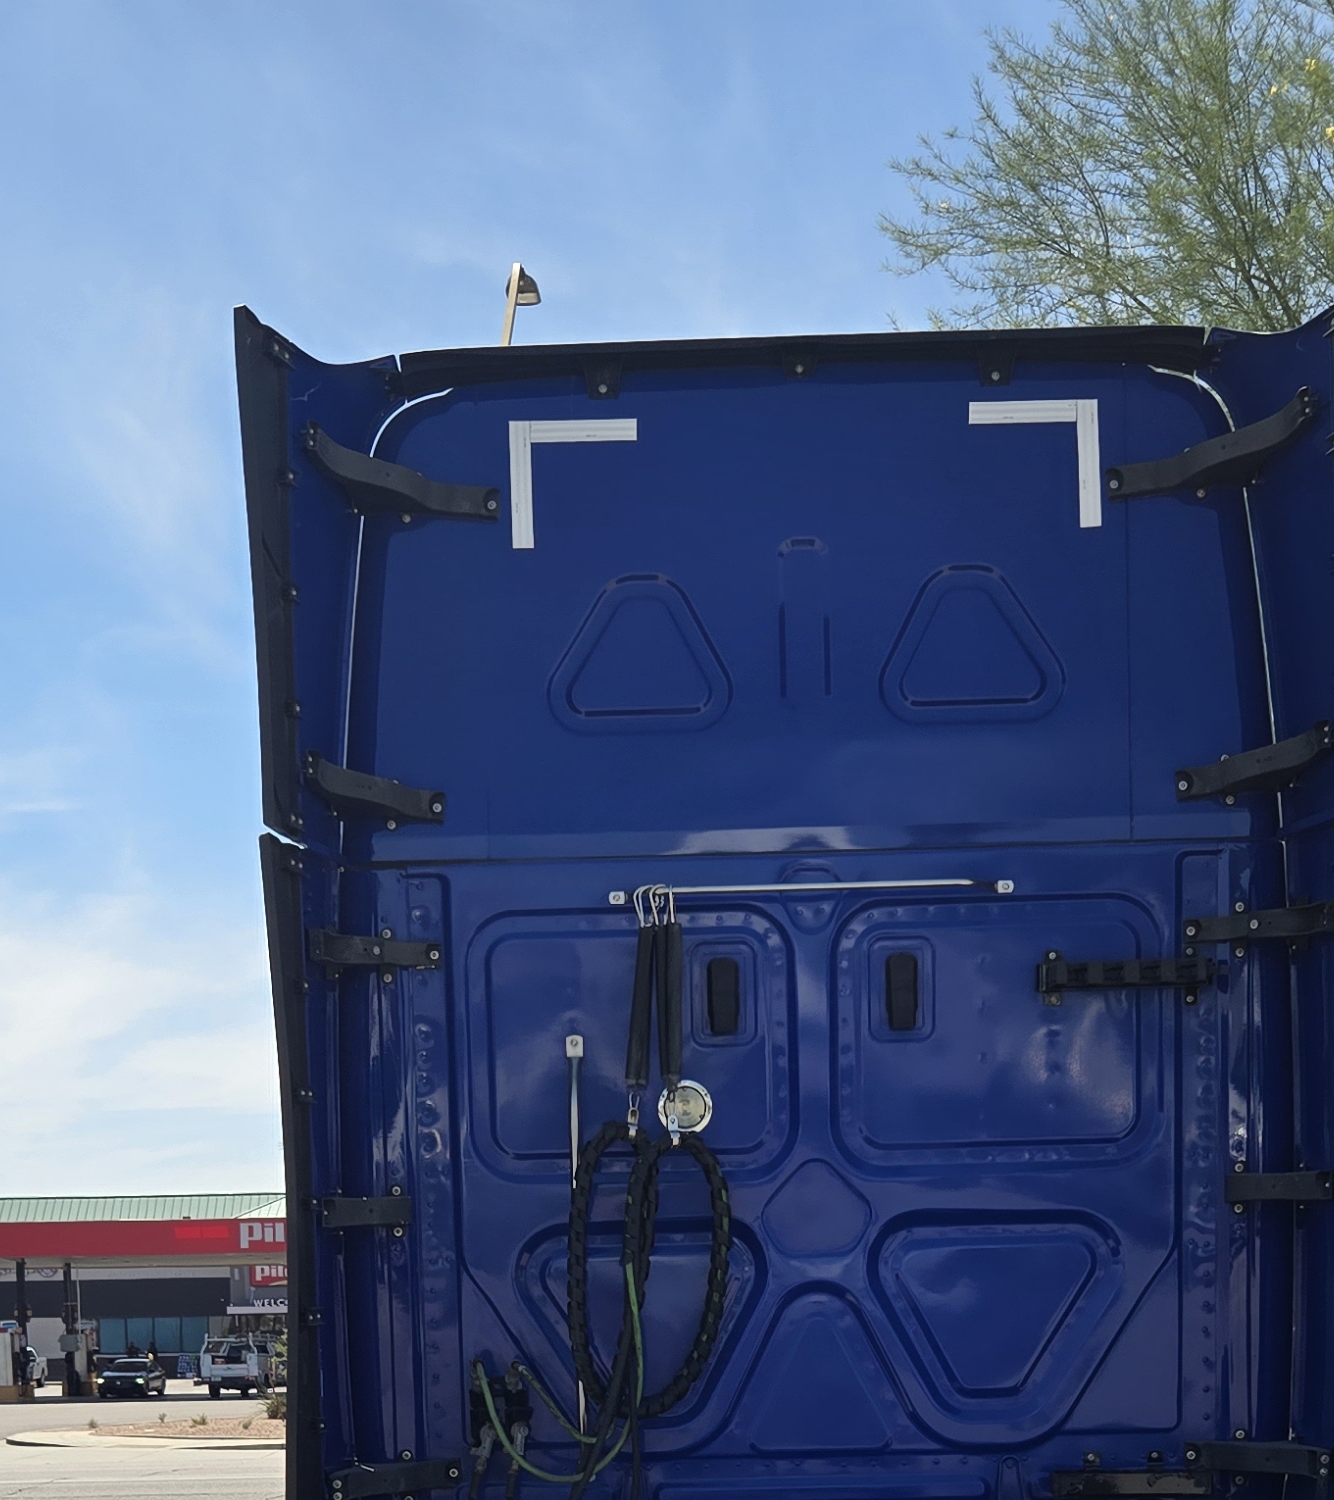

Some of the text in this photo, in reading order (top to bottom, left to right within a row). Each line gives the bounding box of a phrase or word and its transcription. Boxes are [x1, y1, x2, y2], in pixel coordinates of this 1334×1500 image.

[239, 1222, 285, 1249] Pil
[255, 1265, 288, 1281] Pil
[253, 1299, 288, 1307] WELC
